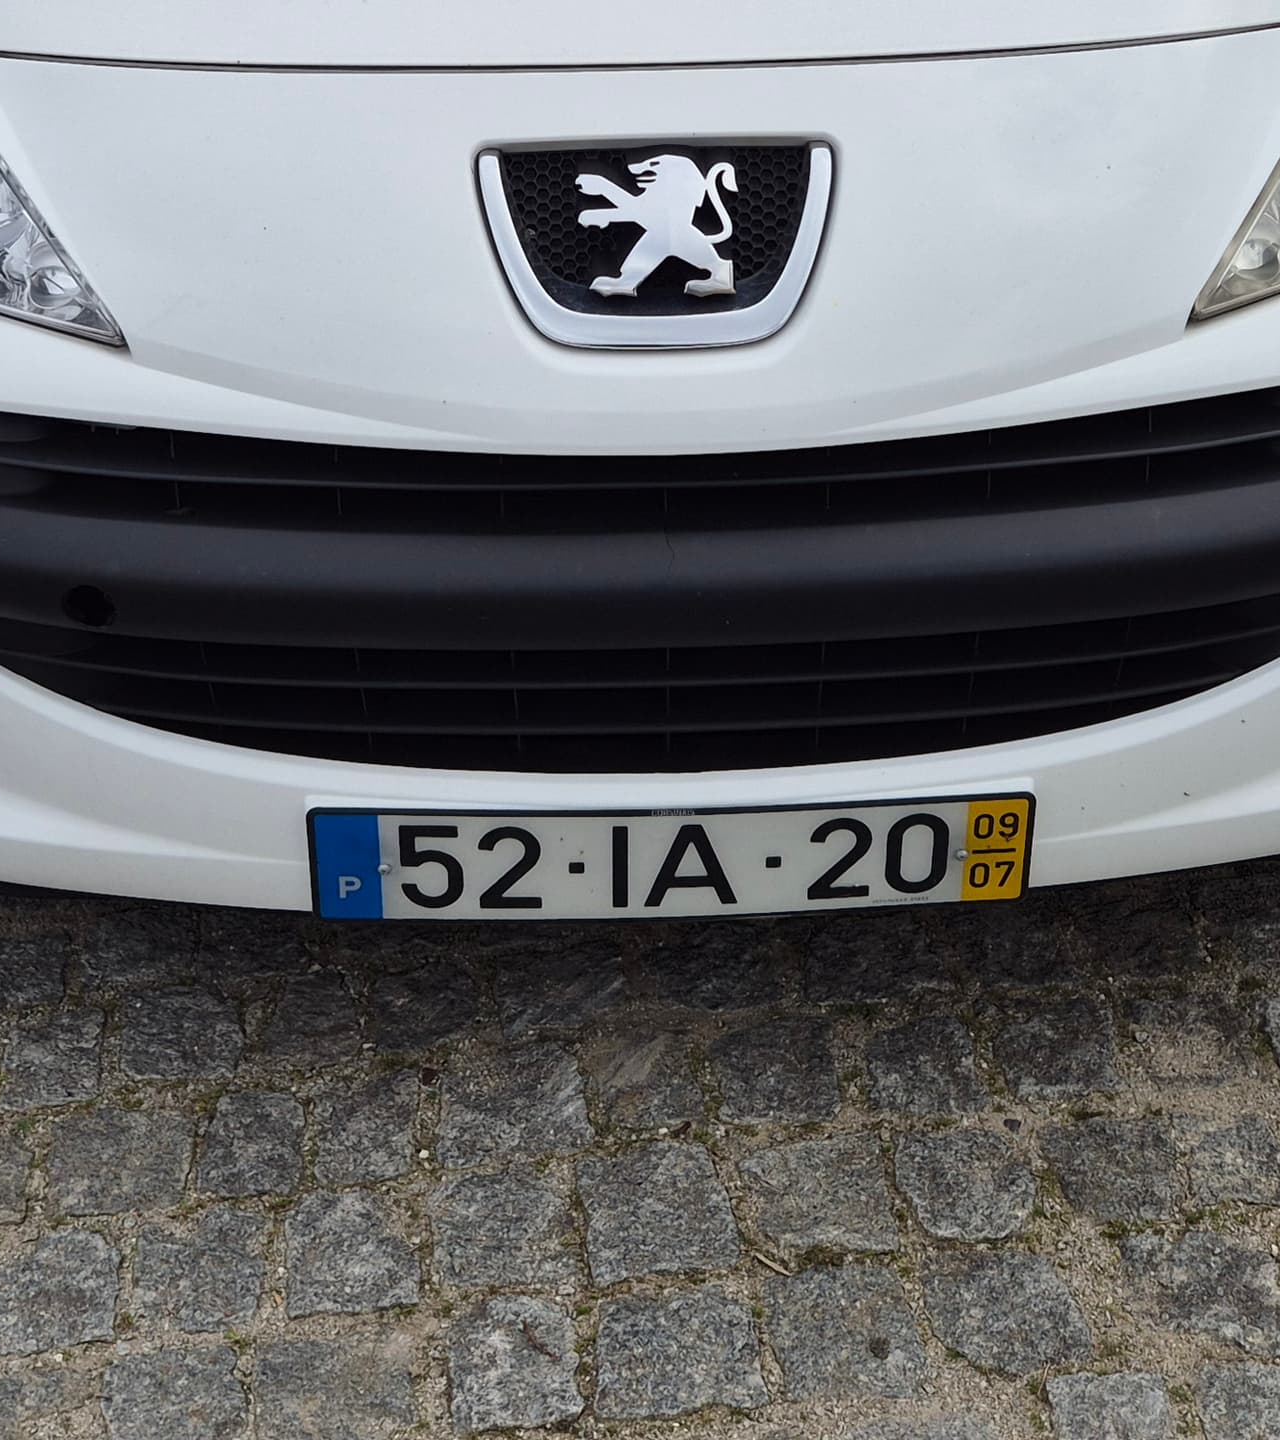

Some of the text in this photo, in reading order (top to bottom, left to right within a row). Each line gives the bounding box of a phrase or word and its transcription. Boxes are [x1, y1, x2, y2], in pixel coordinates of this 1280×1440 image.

[973, 812, 1020, 840] 09
[338, 875, 362, 899] P
[968, 861, 1015, 888] 07
